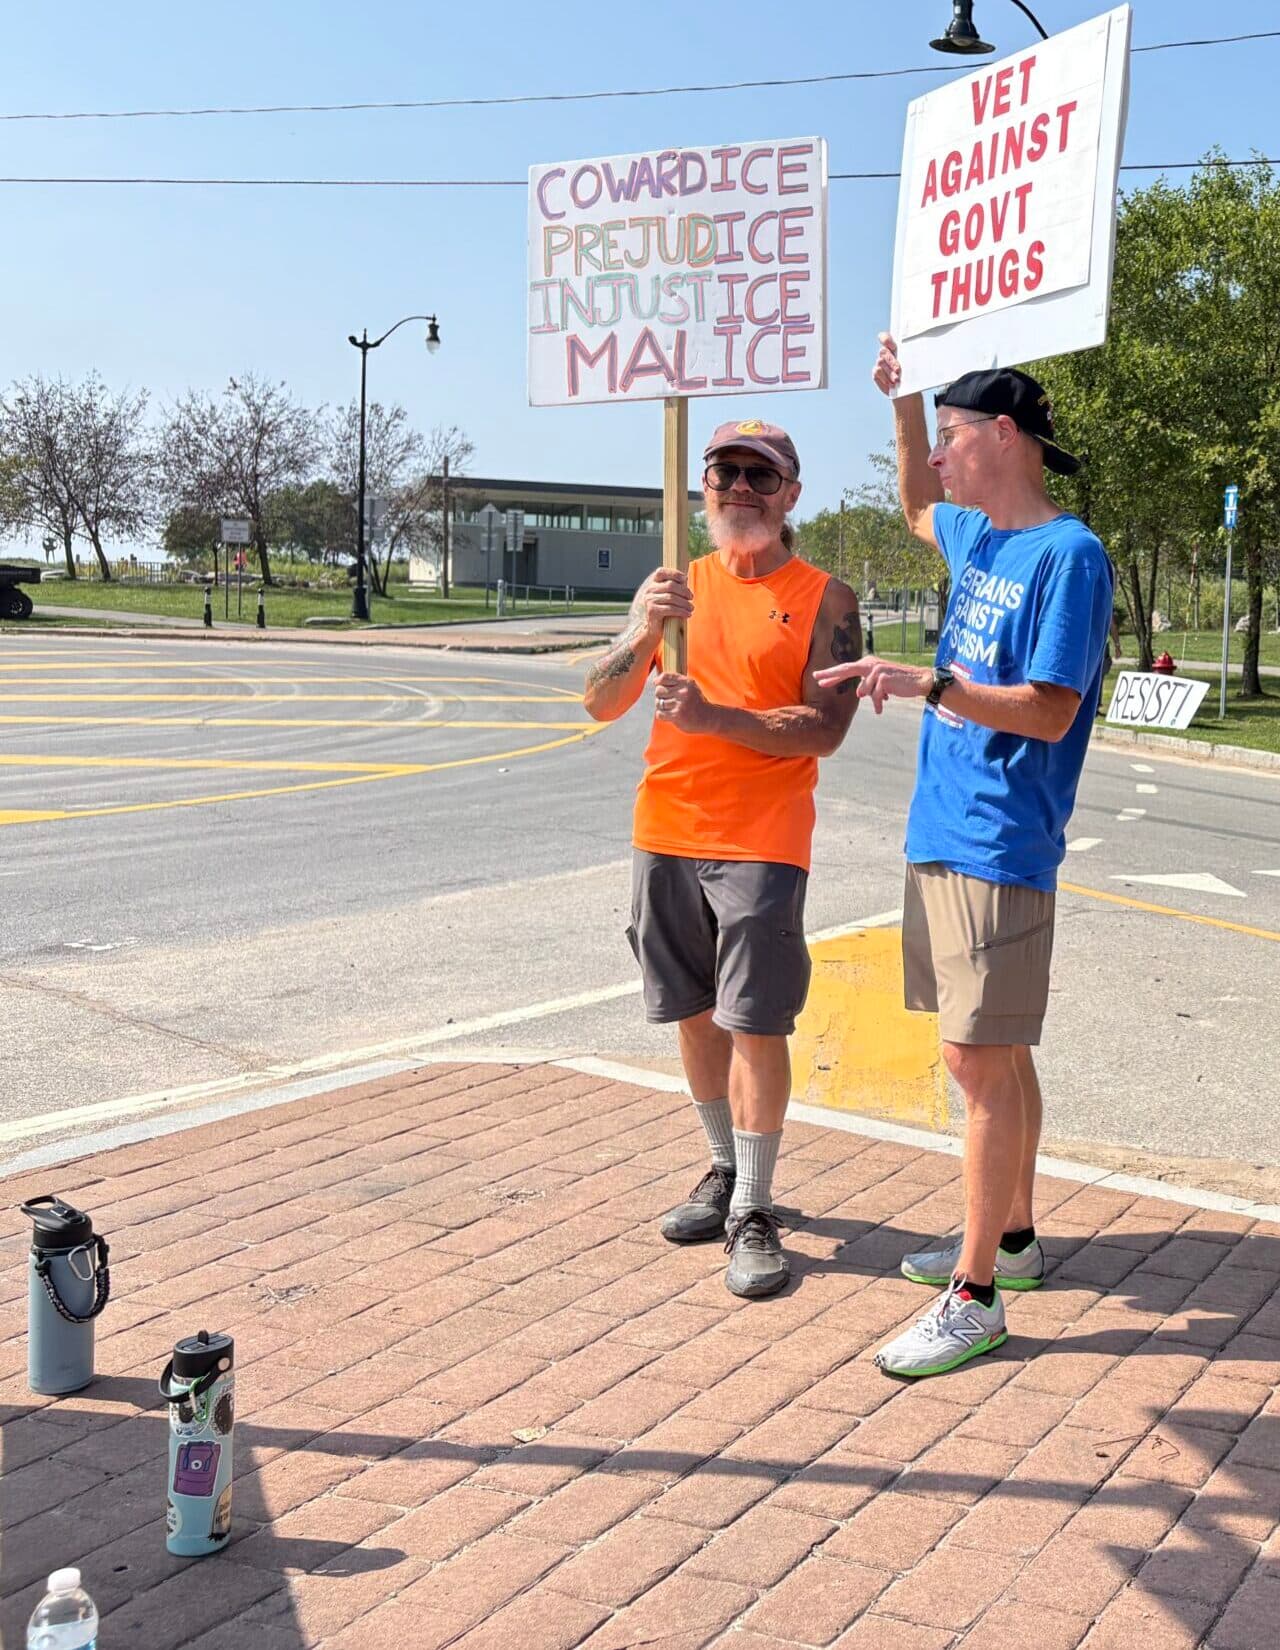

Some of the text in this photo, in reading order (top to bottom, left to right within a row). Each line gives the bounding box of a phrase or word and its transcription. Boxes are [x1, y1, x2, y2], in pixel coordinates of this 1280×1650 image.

[971, 55, 1036, 126] VET
[536, 144, 813, 220] COWARDICE
[921, 101, 1077, 208] AGAINST
[543, 206, 813, 277] PREJUDICE
[939, 182, 1033, 257] GOVT
[529, 270, 811, 334] INJUSTICE
[931, 240, 1046, 318] THUGS
[566, 323, 815, 397] MALICE
[1110, 676, 1194, 725] RESIST!
